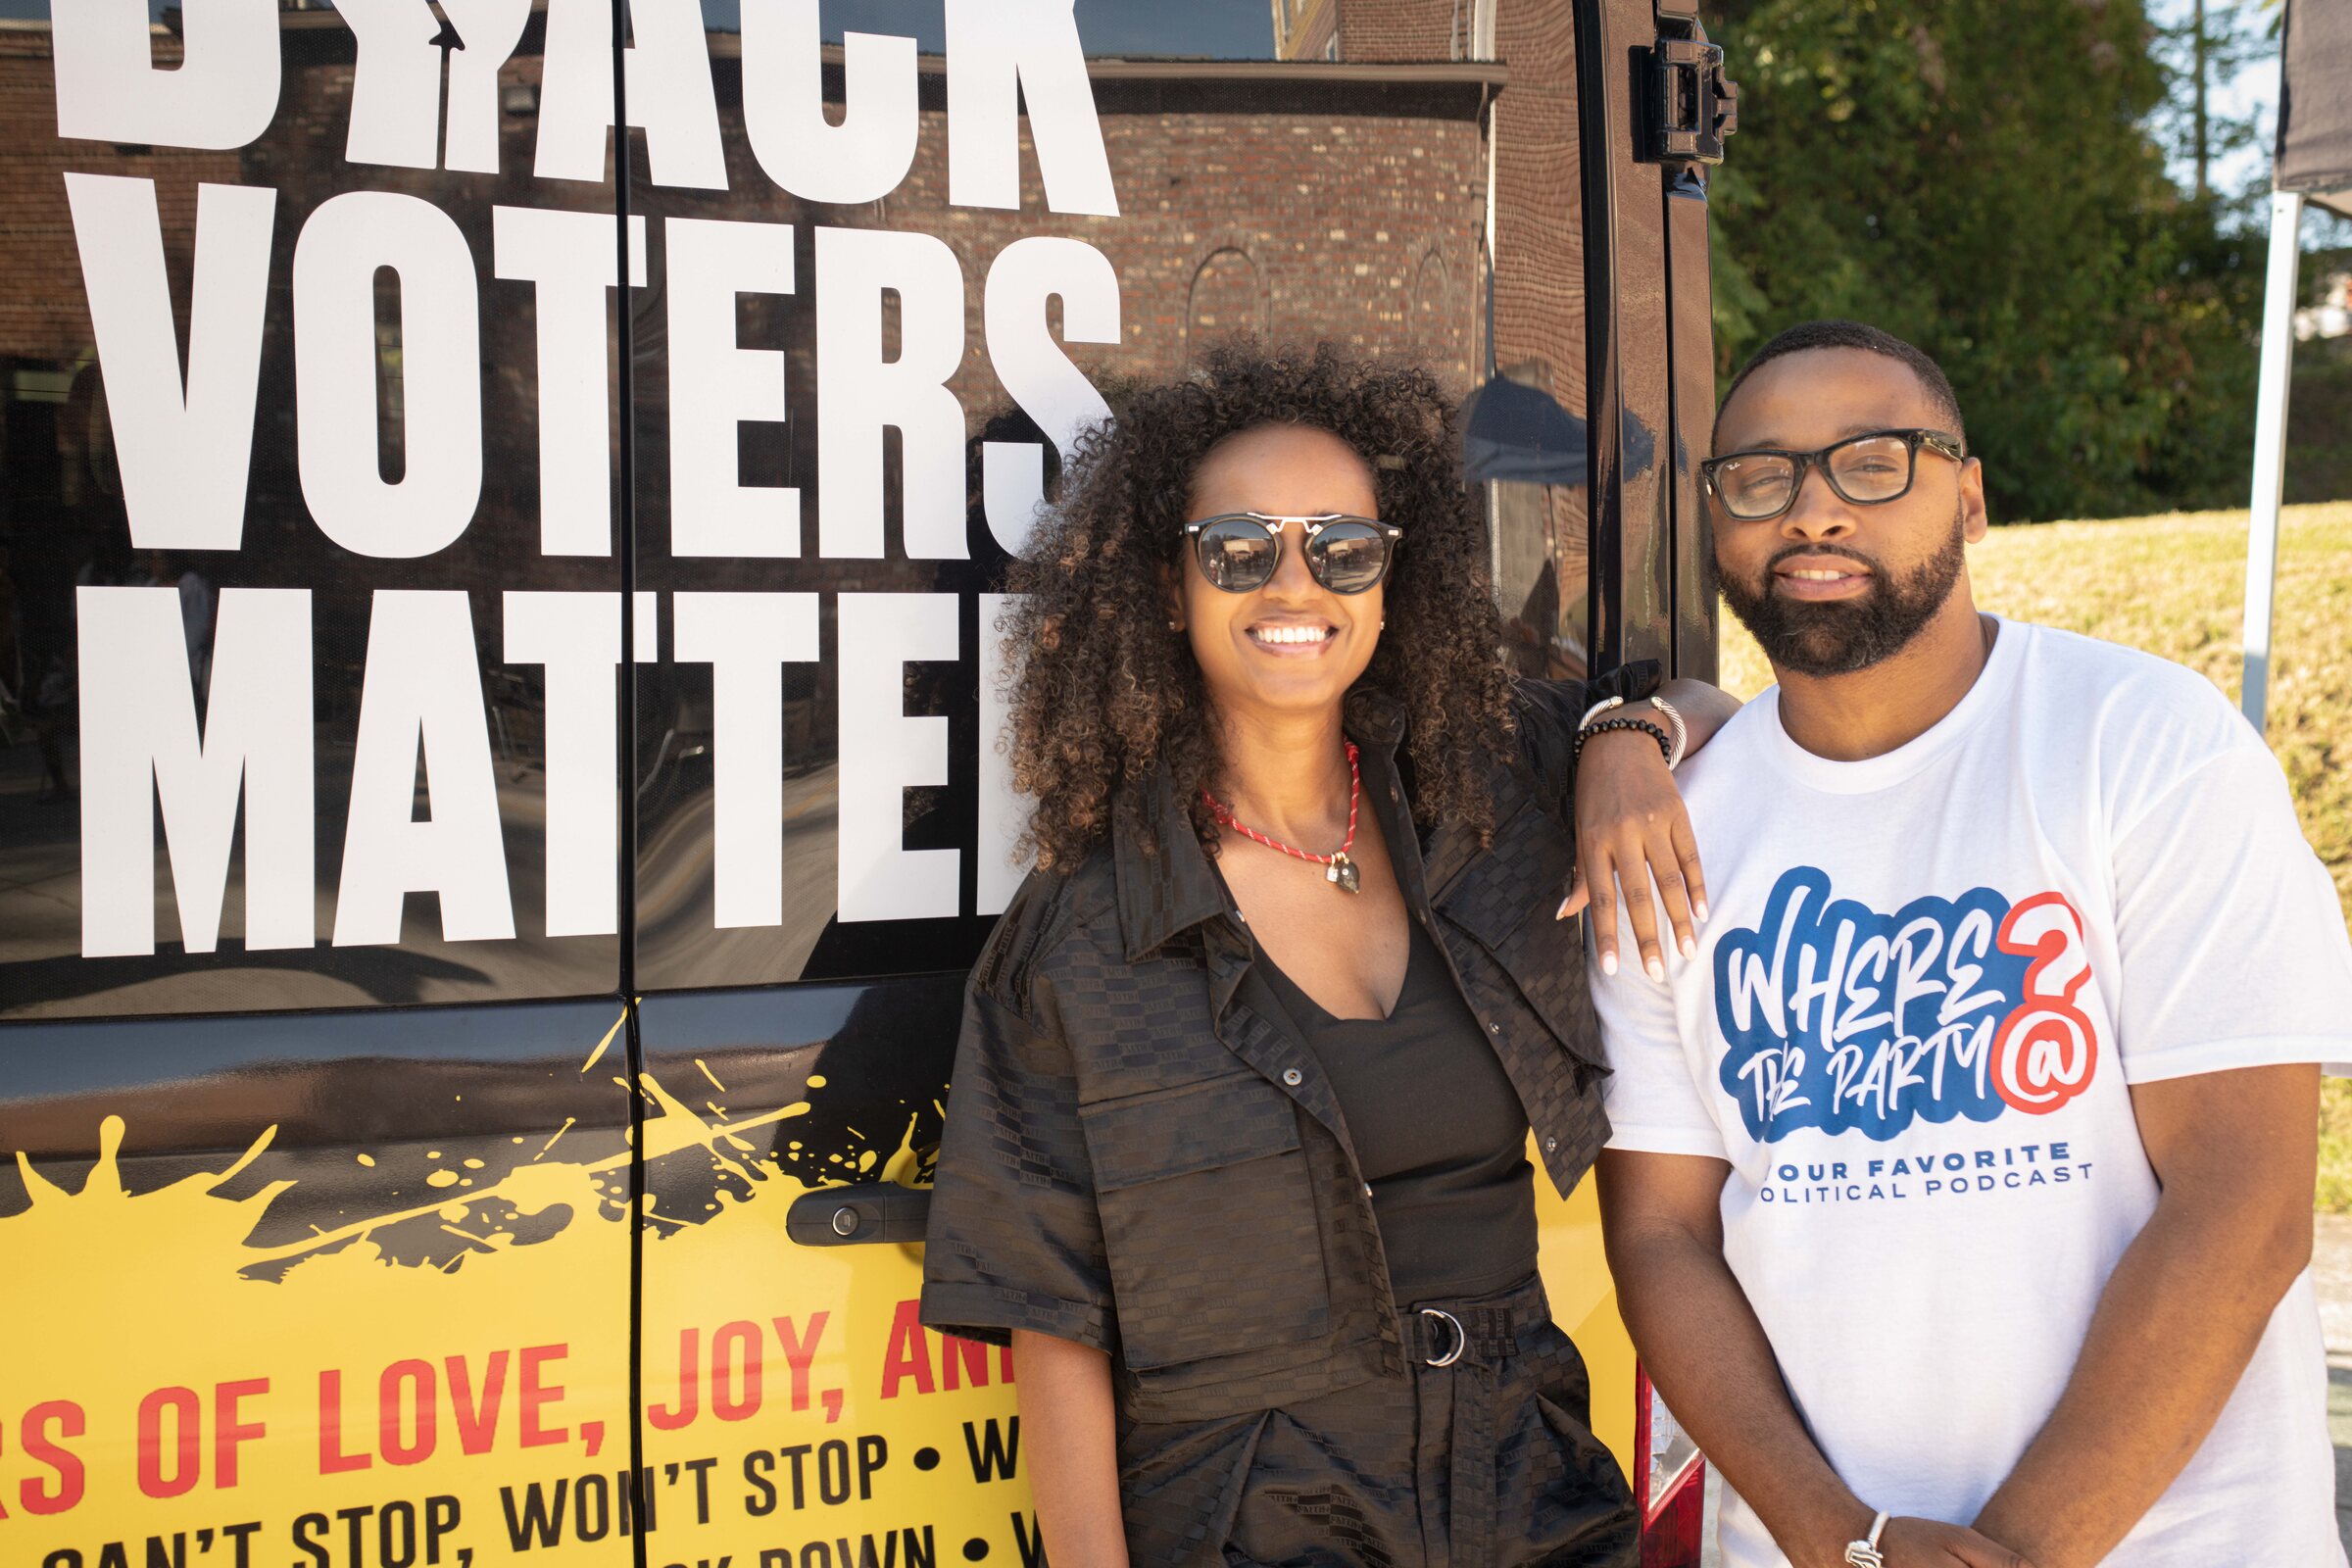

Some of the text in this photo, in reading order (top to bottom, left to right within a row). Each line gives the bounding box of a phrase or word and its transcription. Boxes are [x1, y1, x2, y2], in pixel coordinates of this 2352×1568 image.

[64, 172, 1121, 559] VOTERS
[1729, 886, 2006, 1053] WHERE
[1827, 1016, 1995, 1120] PARTY
[1761, 1164, 2091, 1203] OLITICAL PODCAST
[1765, 1143, 2070, 1182] OUR FAVORITE
[0, 1399, 85, 1519] S
[138, 1378, 270, 1498] OF
[319, 1344, 605, 1474] LOVE,
[648, 1312, 843, 1430] JOY,
[881, 1298, 1014, 1399] AN
[293, 1496, 471, 1568] STOP,
[501, 1458, 716, 1551] WON'T
[745, 1436, 887, 1515] STOP
